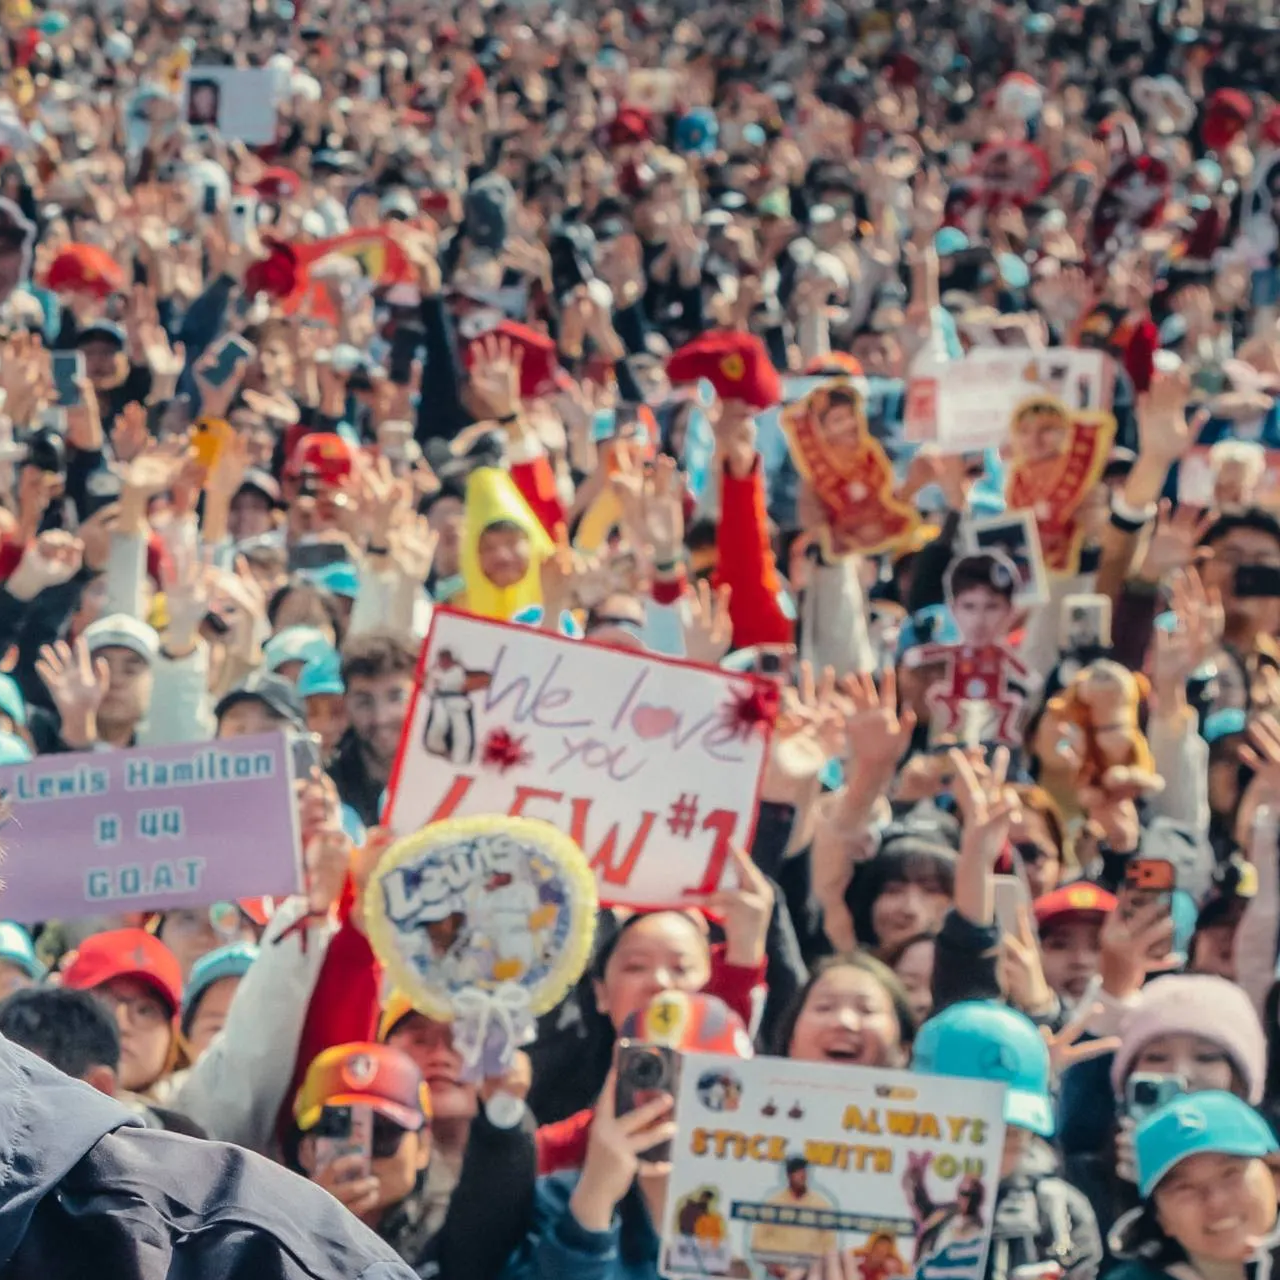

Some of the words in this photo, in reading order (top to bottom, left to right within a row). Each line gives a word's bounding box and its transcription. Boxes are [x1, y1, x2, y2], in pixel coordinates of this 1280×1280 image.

[16, 768, 107, 801] Lewis
[127, 751, 272, 788] Hamilton
[139, 808, 183, 837] 44
[841, 1104, 989, 1146] ALWAYS
[691, 1126, 787, 1162] STICK
[803, 1138, 894, 1174] WITH
